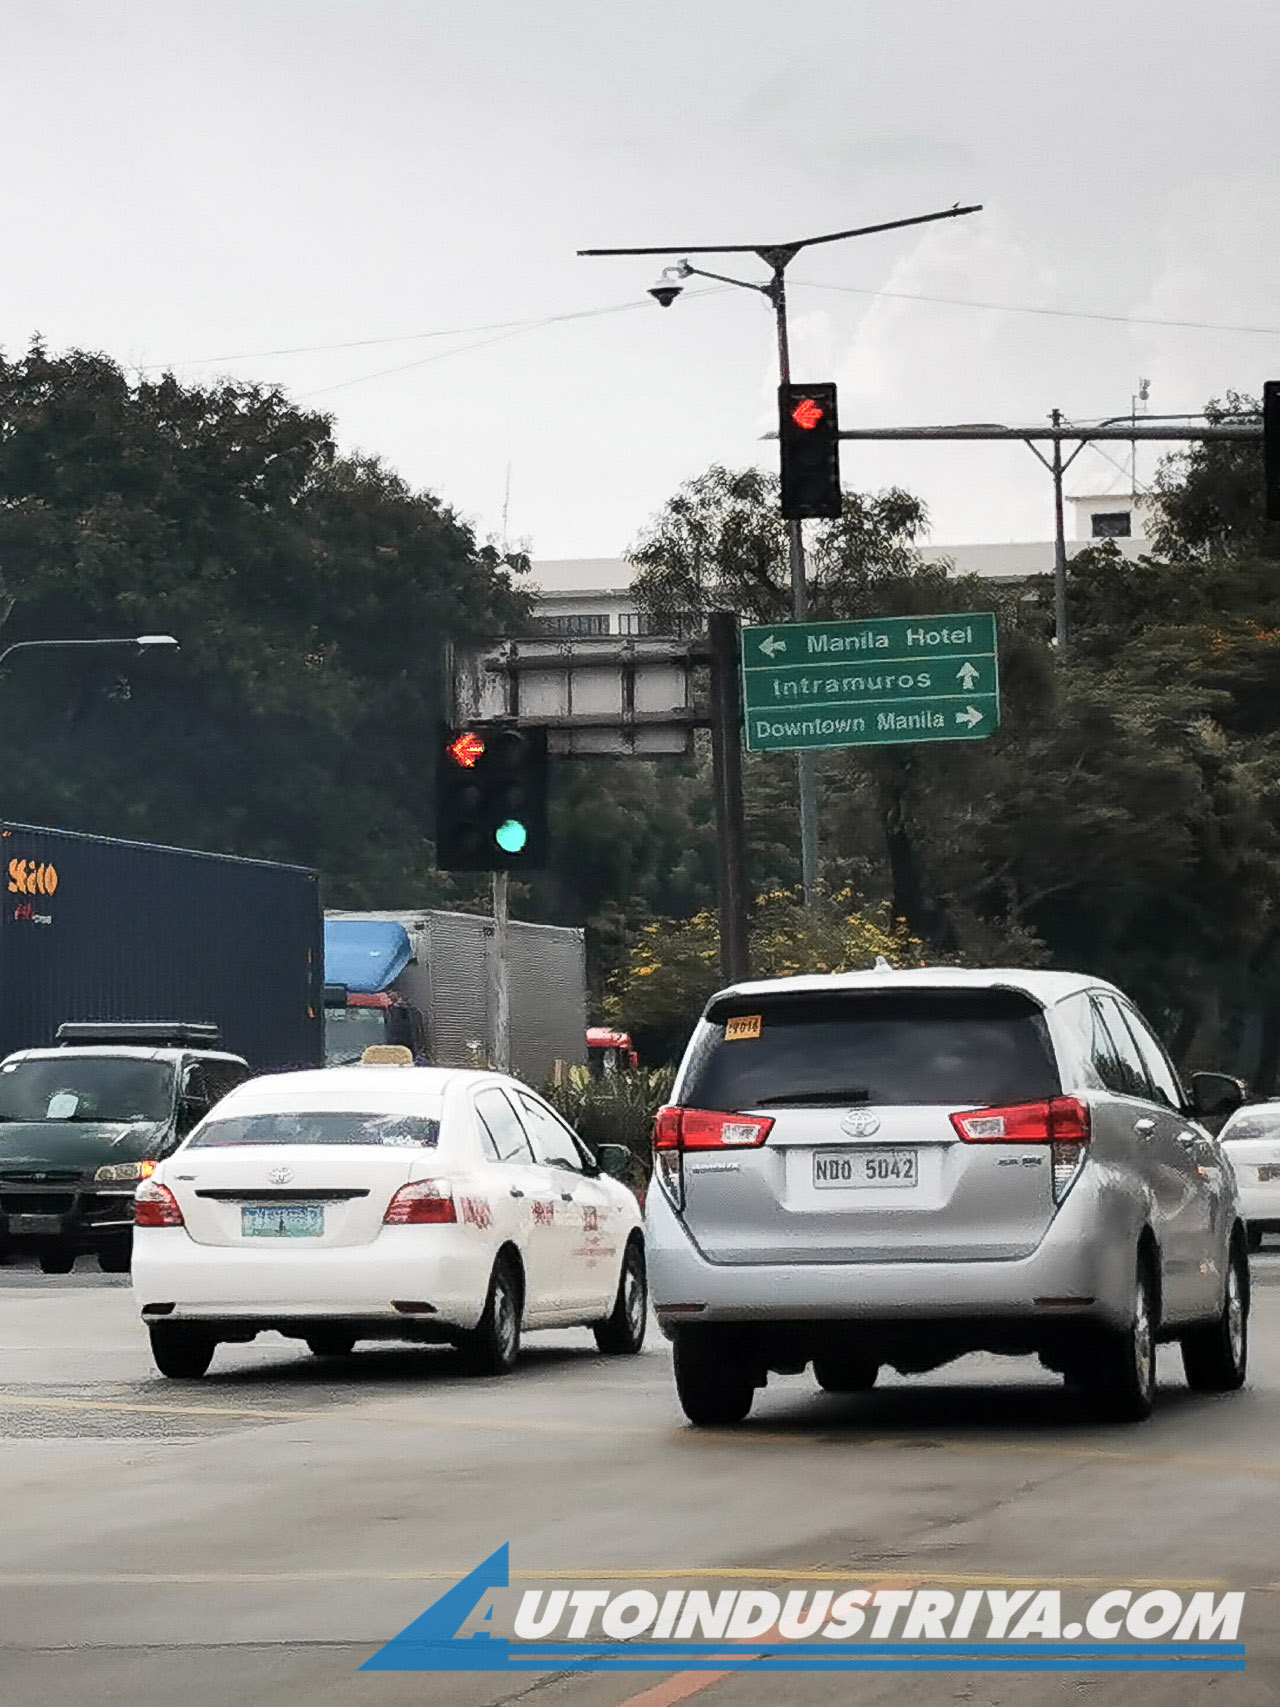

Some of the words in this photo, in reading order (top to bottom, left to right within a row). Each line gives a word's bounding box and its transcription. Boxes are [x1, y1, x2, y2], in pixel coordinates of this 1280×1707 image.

[806, 631, 889, 653] Manila
[906, 625, 972, 646] Hotel
[772, 671, 932, 698] Intramuros
[756, 713, 866, 739] Downtown
[876, 711, 945, 732] Manila
[865, 1158, 914, 1180] 5042
